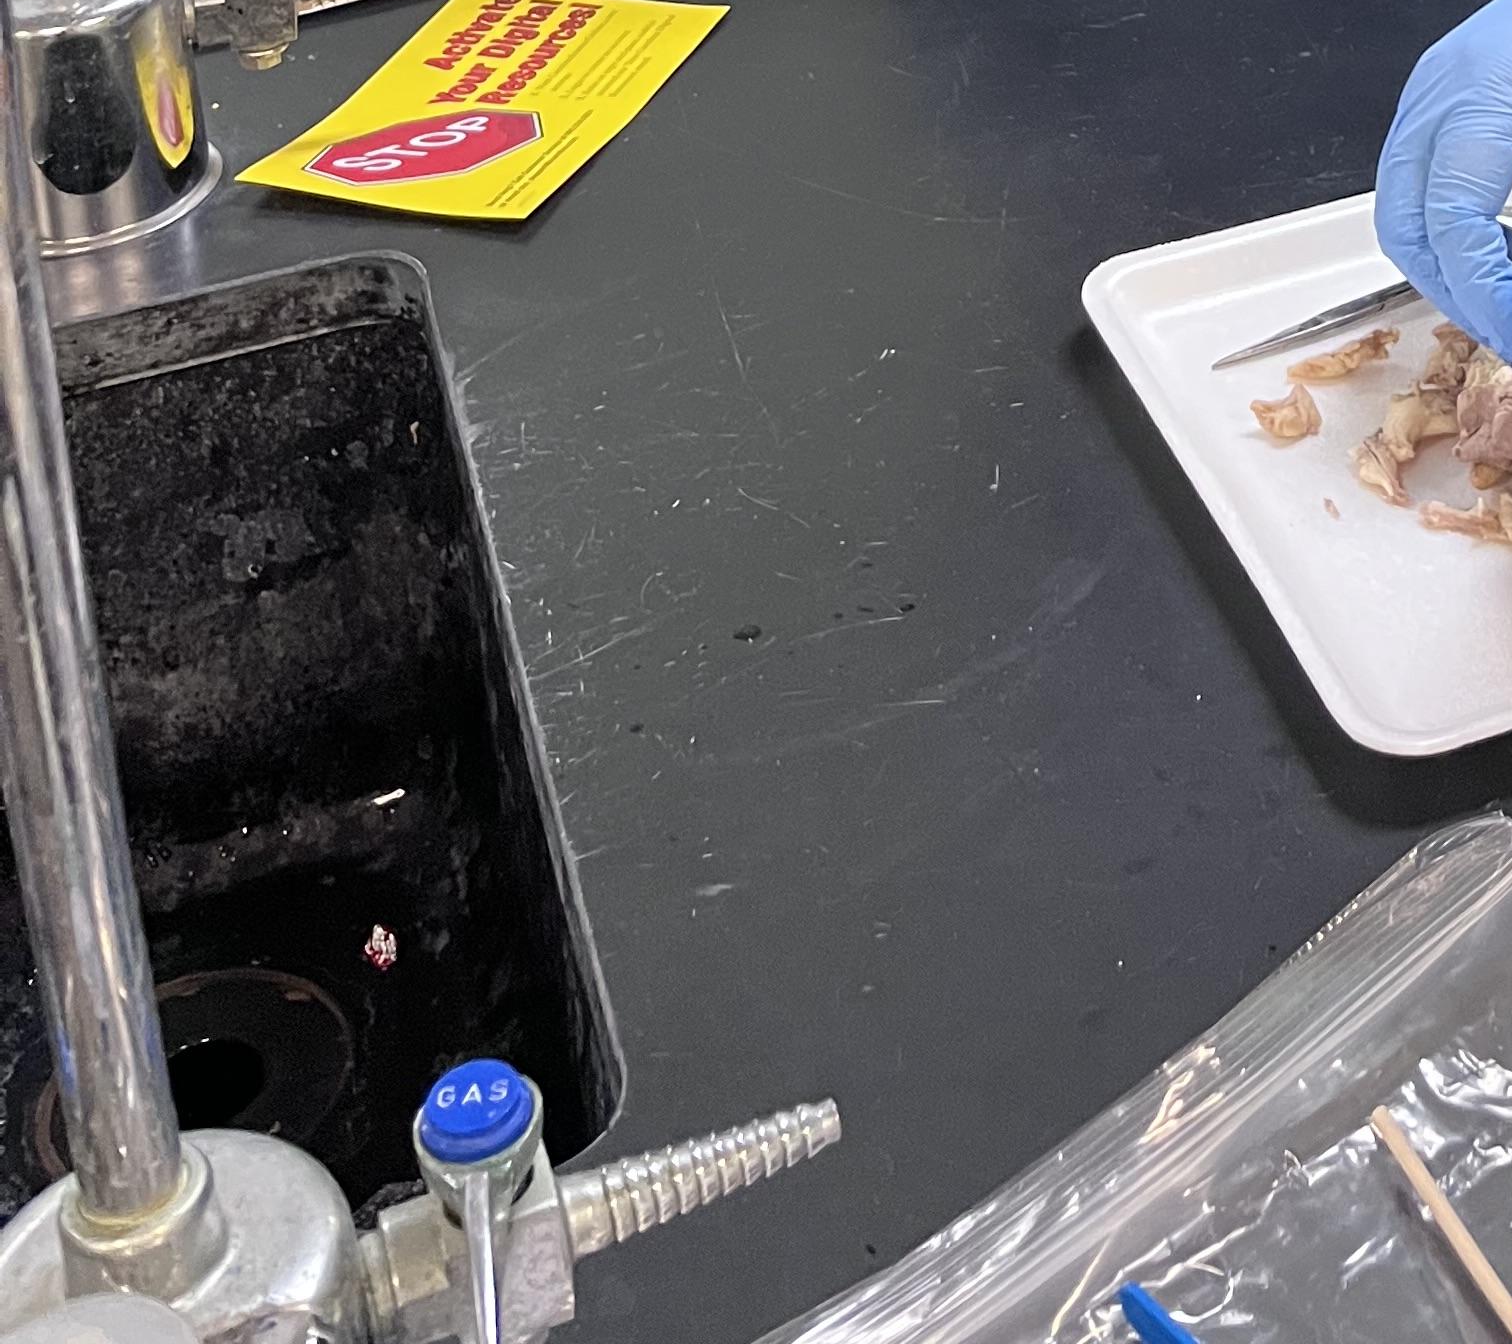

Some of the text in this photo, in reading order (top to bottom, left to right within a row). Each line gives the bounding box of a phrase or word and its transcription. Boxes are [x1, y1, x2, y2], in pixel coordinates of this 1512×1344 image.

[427, 62, 497, 104] Your
[477, 0, 563, 58] Digital
[475, 2, 604, 104] Resources!
[332, 116, 489, 172] STOP
[437, 1078, 509, 1109] GAS
